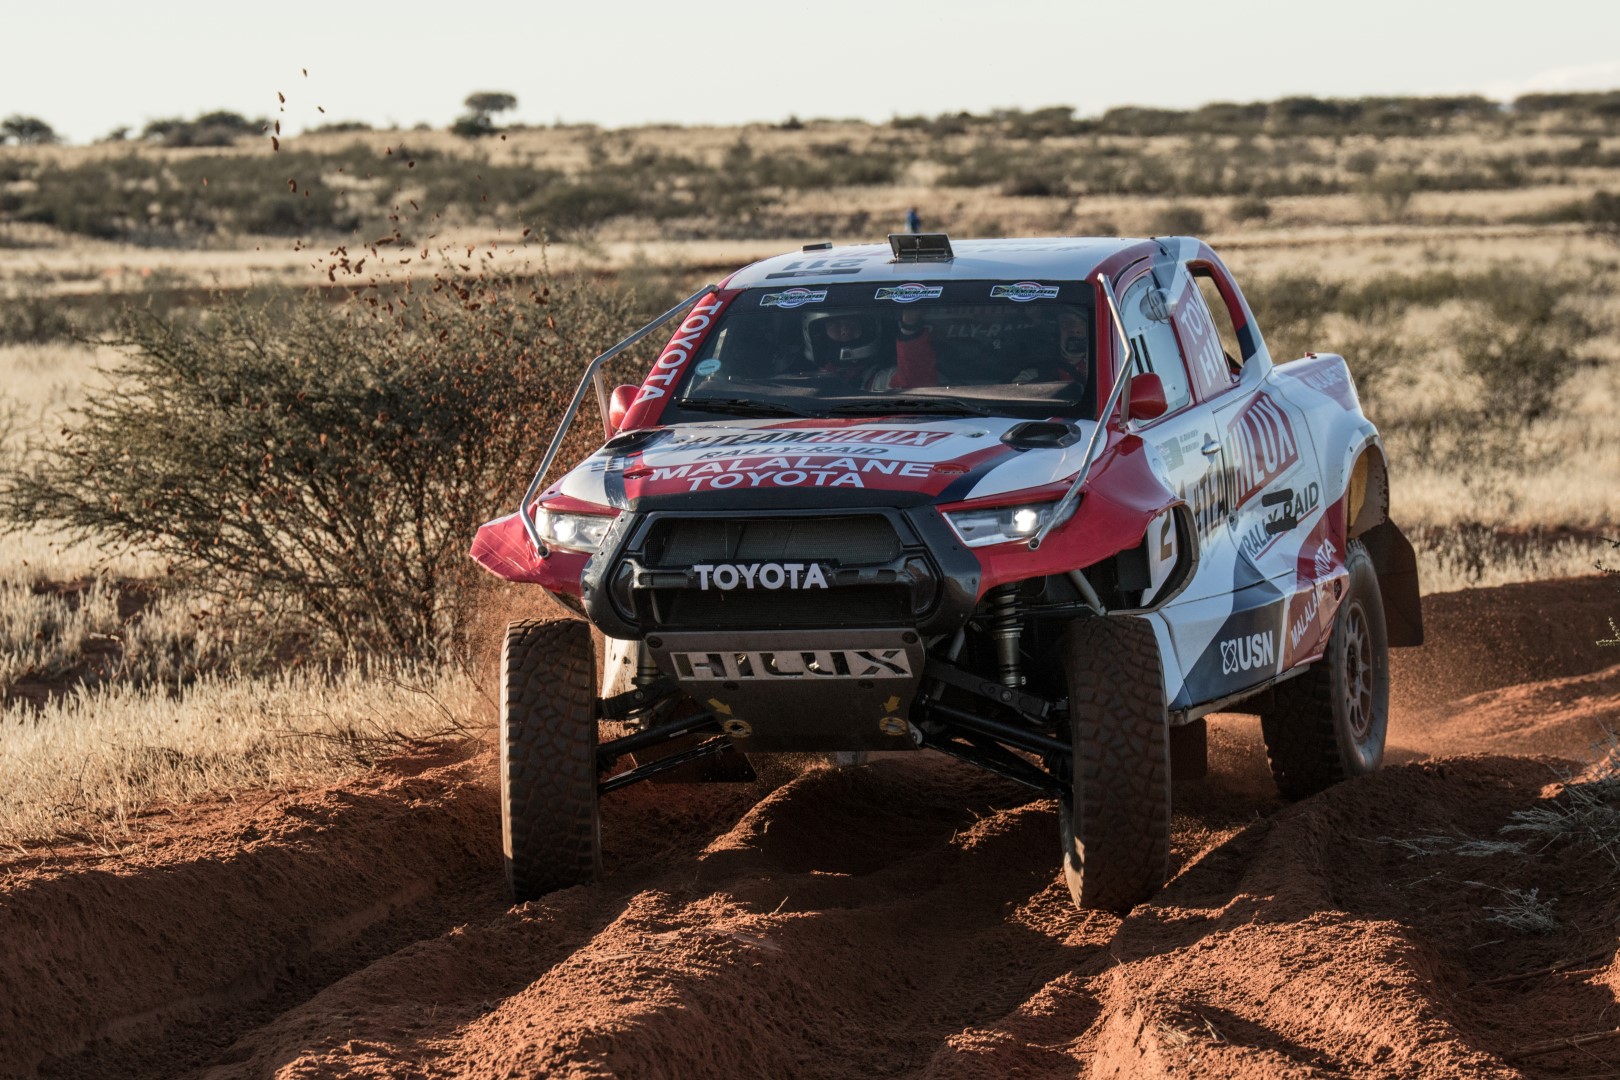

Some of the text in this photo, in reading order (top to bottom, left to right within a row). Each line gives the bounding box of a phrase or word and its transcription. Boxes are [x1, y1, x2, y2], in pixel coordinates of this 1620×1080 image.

[634, 301, 723, 406] TOYOTA
[695, 446, 889, 461] RALLY-RAID
[650, 456, 935, 482] MALALANE
[687, 470, 865, 491] TOYOTA
[694, 563, 829, 590] TOYOTA
[1290, 584, 1325, 650] MALALANE
[1238, 630, 1275, 670] USN
[674, 651, 910, 679] HILUX
